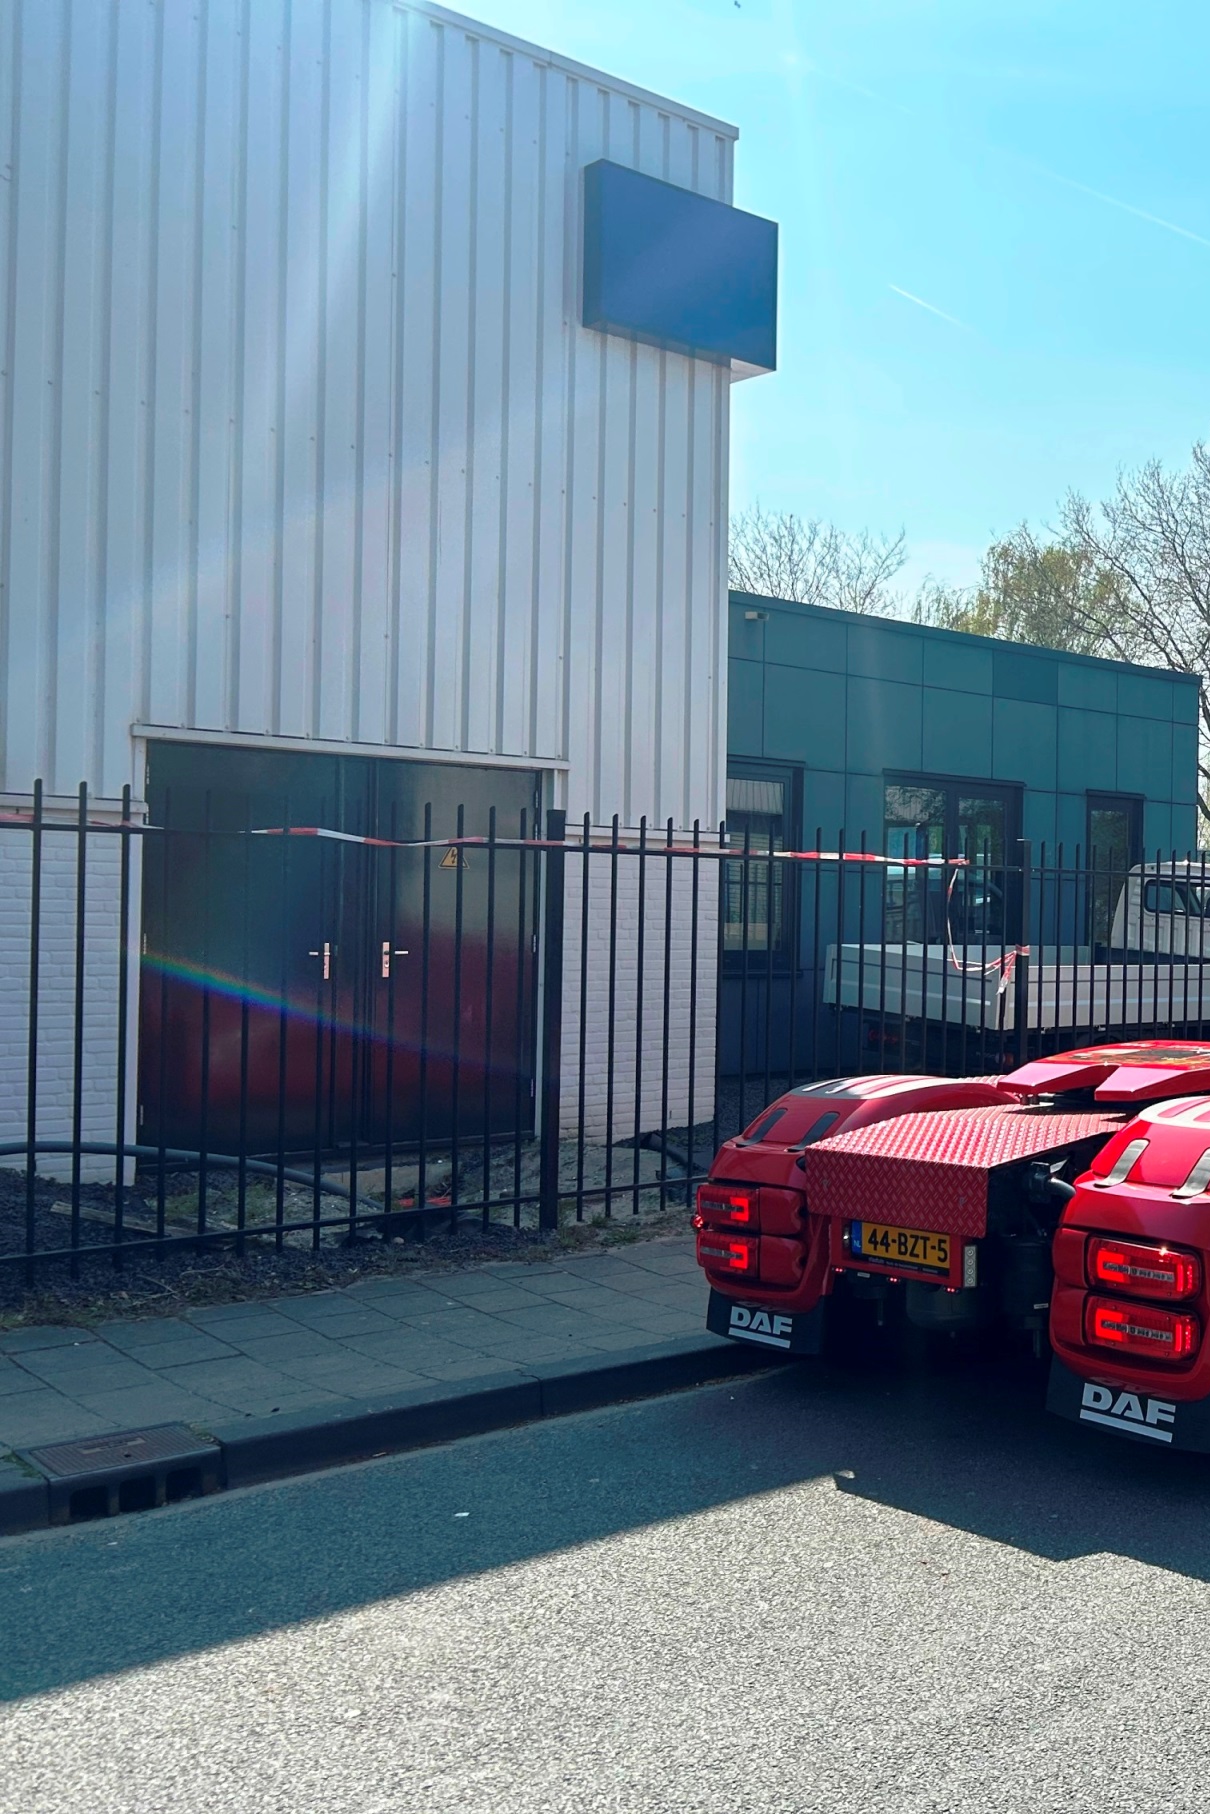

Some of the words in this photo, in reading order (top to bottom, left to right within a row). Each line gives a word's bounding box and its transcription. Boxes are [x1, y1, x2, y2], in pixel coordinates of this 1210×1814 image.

[853, 1240, 862, 1248] NL
[867, 1228, 948, 1263] 44-BZT-5
[729, 1305, 793, 1335] DAF
[1081, 1382, 1177, 1425] DAF
